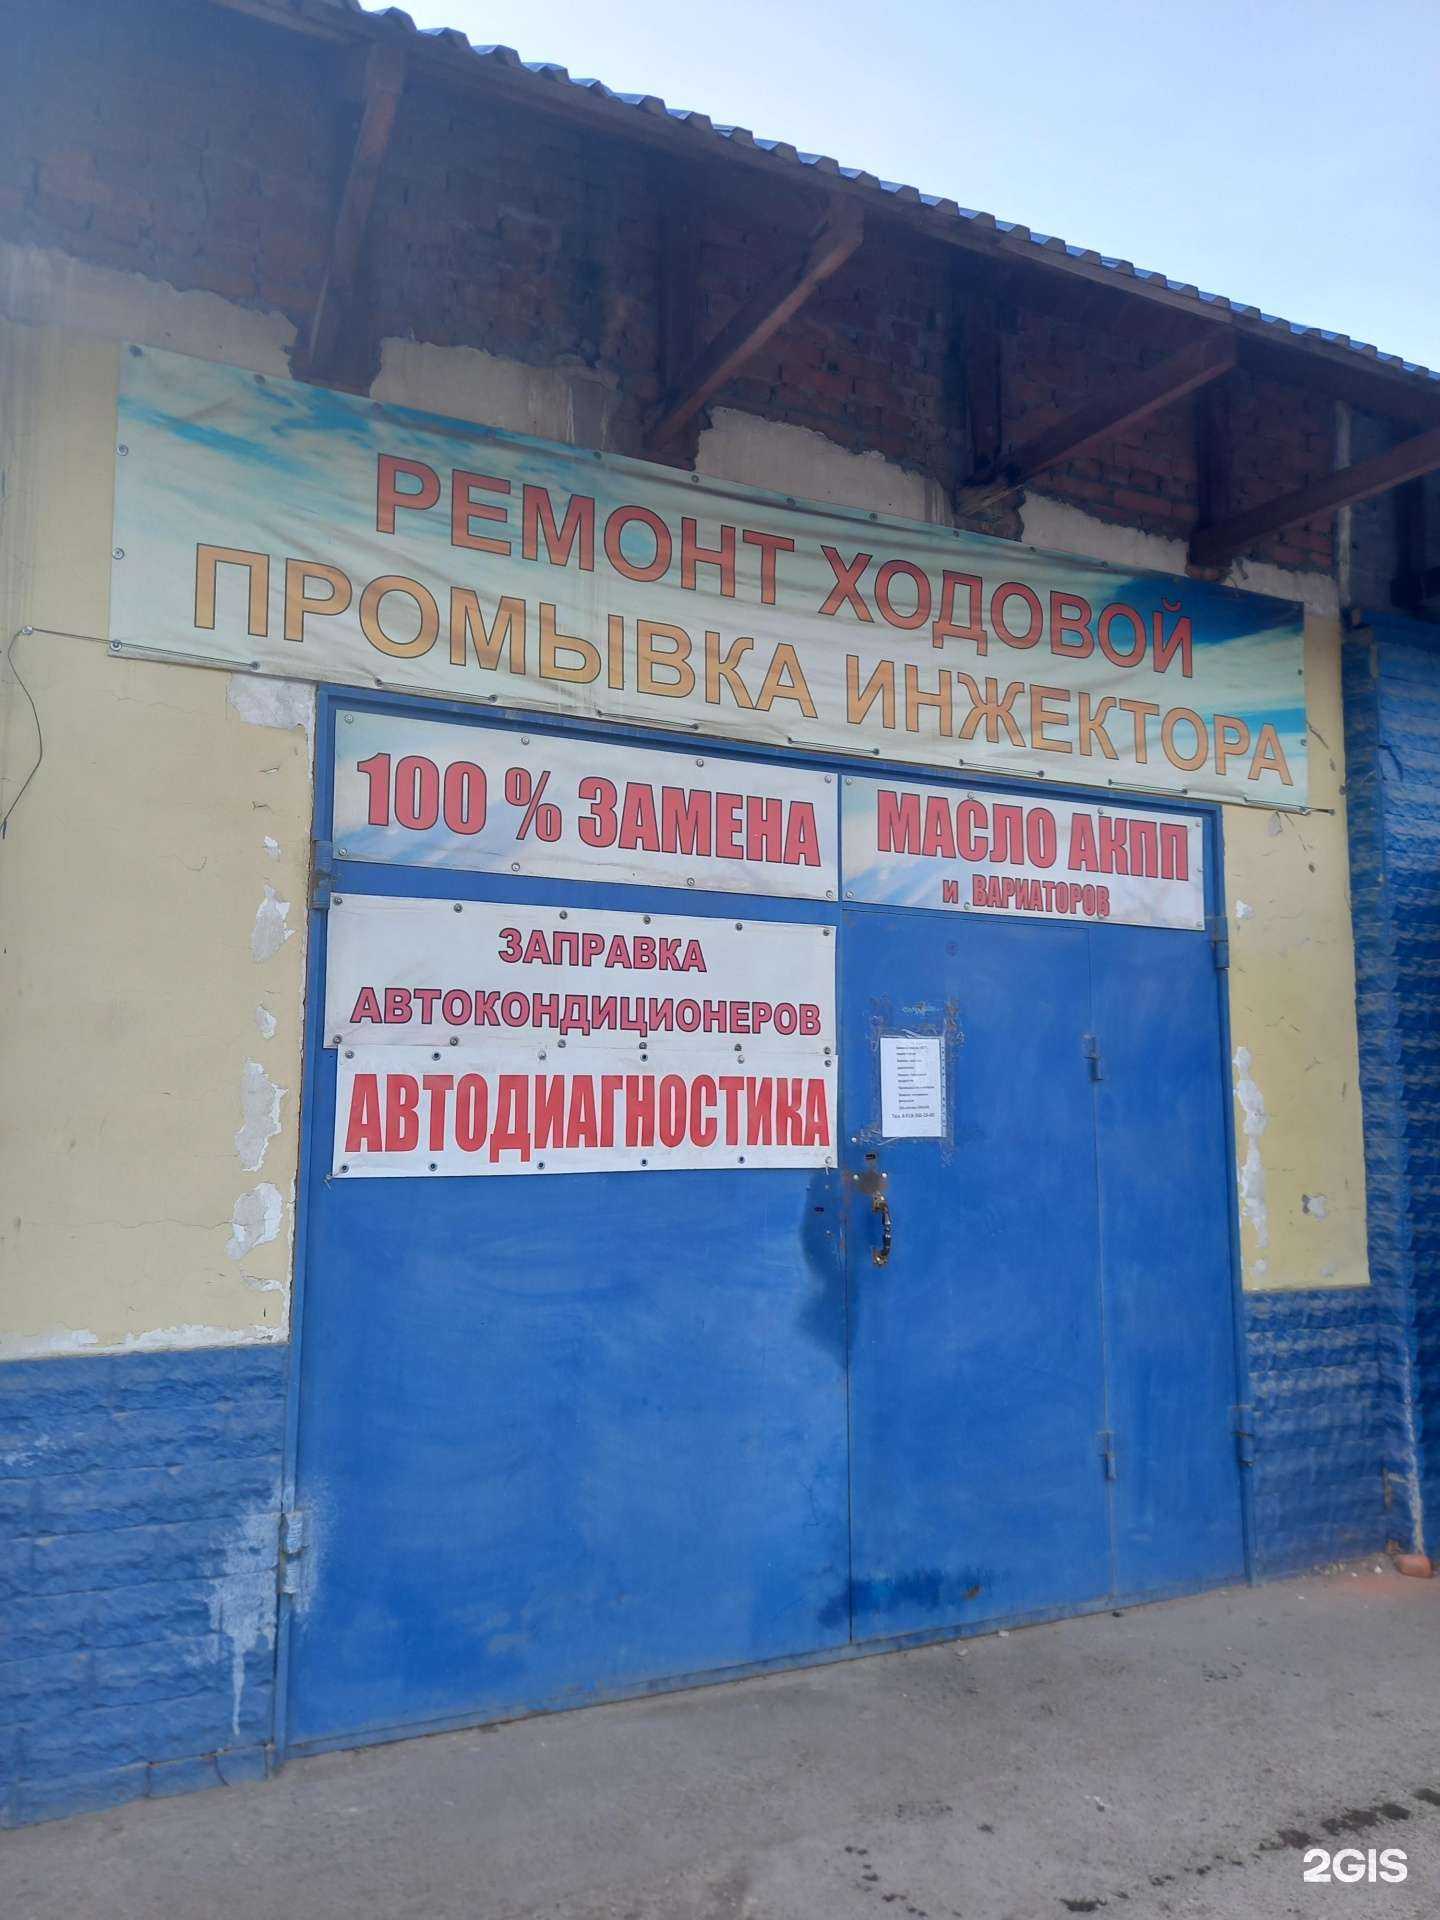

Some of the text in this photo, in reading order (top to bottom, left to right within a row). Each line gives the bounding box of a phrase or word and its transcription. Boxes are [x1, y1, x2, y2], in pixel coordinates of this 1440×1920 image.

[376, 453, 1193, 678] РЕМОНТ ХОДОВОЙ
[194, 543, 1294, 786] ПРОМЫВКА ИНЖЕКТОРА
[357, 753, 822, 867] 100 % ЗАМЕНА
[877, 790, 1189, 881] МАСЛО АКПП
[972, 874, 1110, 917] ВАРИАТОРОВ
[499, 928, 707, 972] ЗАПРАВКА
[350, 987, 821, 1037] АВТОКОНДИЦИОНЕРОВ
[345, 1073, 830, 1162] АВТОДИАГНОСТИКА
